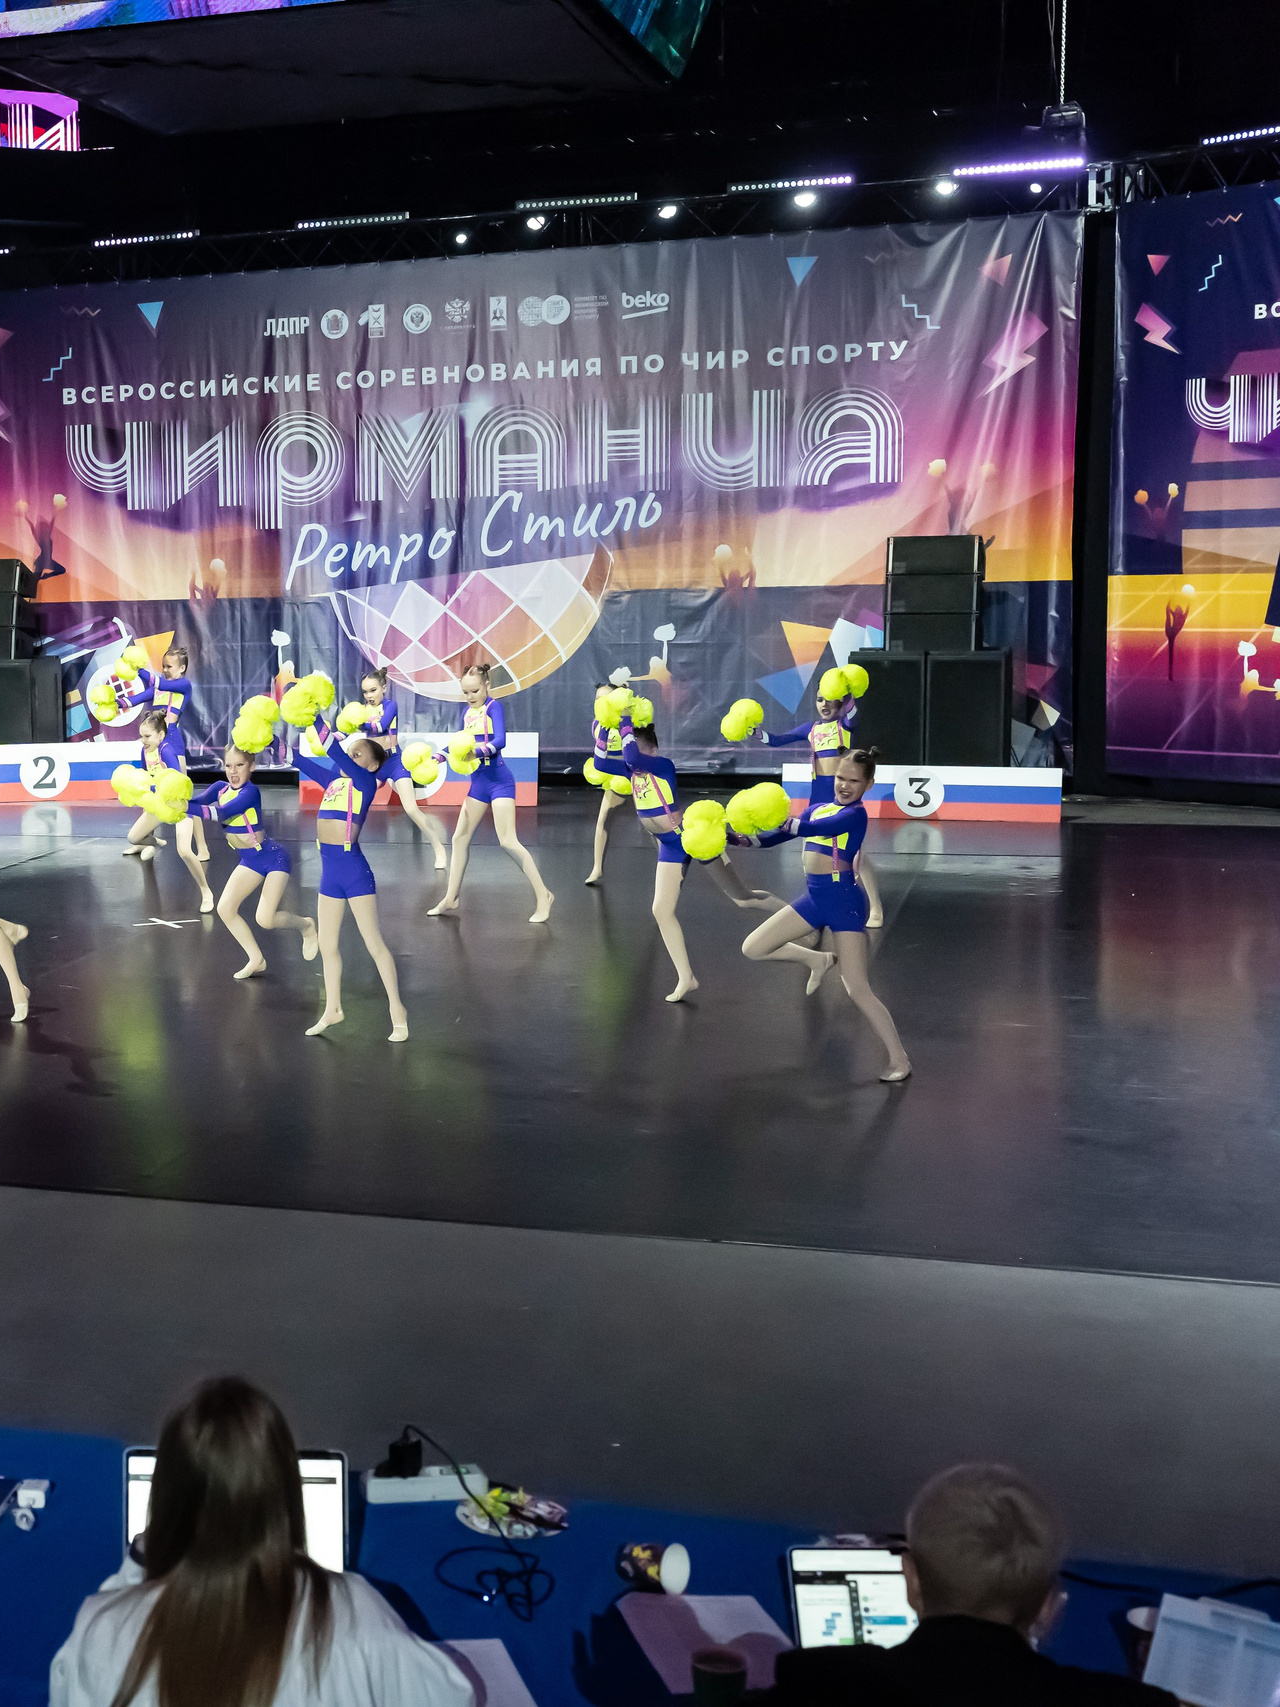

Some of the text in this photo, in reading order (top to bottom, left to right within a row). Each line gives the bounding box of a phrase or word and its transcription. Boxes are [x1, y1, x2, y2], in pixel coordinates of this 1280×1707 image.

[621, 290, 670, 308] beko
[264, 316, 310, 338] ЛДПР
[62, 340, 909, 406] ВСЕРОССИЙСКИЕ СОРЕВНОВАНИЯ ПО ЧИР СПОРТУ
[285, 489, 663, 590] Ретро Стиль
[32, 756, 57, 789] 2
[907, 777, 931, 809] 3
